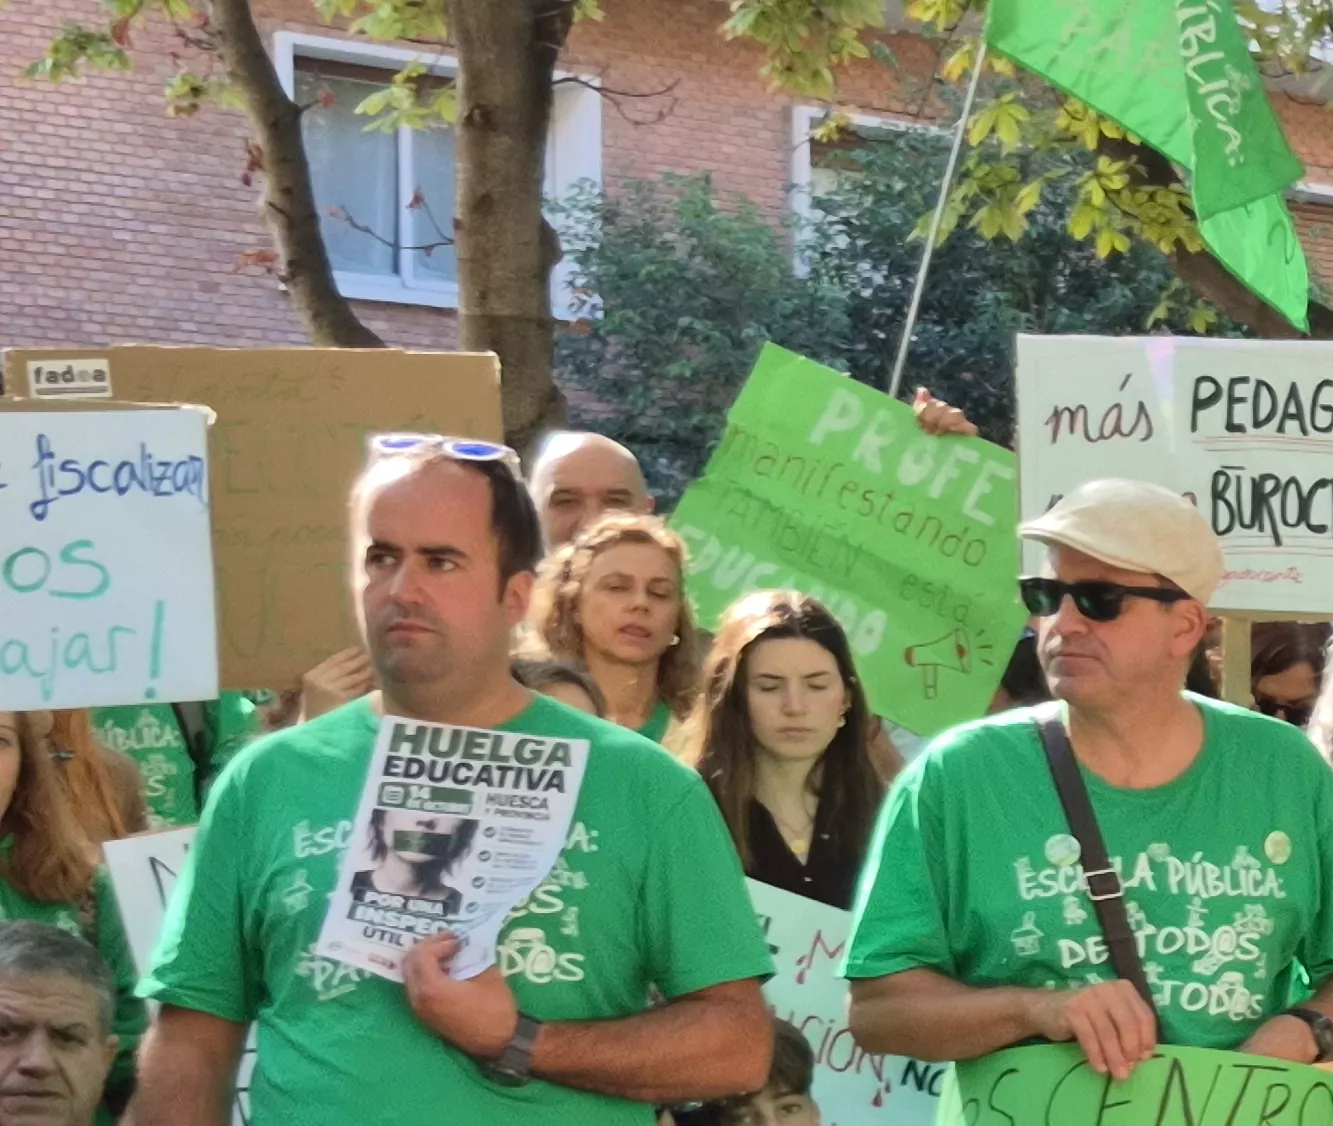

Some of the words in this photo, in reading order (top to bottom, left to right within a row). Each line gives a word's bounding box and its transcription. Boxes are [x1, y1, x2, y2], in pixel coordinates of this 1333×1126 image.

[1045, 373, 1154, 444] más
[810, 388, 1015, 526] PROFE
[728, 422, 987, 567] manifestando
[0, 600, 166, 700] ajar!
[389, 722, 572, 767] HUELGA
[382, 755, 567, 793] EDUCATIVA
[355, 904, 456, 934] INSPEC
[364, 891, 405, 908] POR
[1057, 936, 1108, 969] DE
